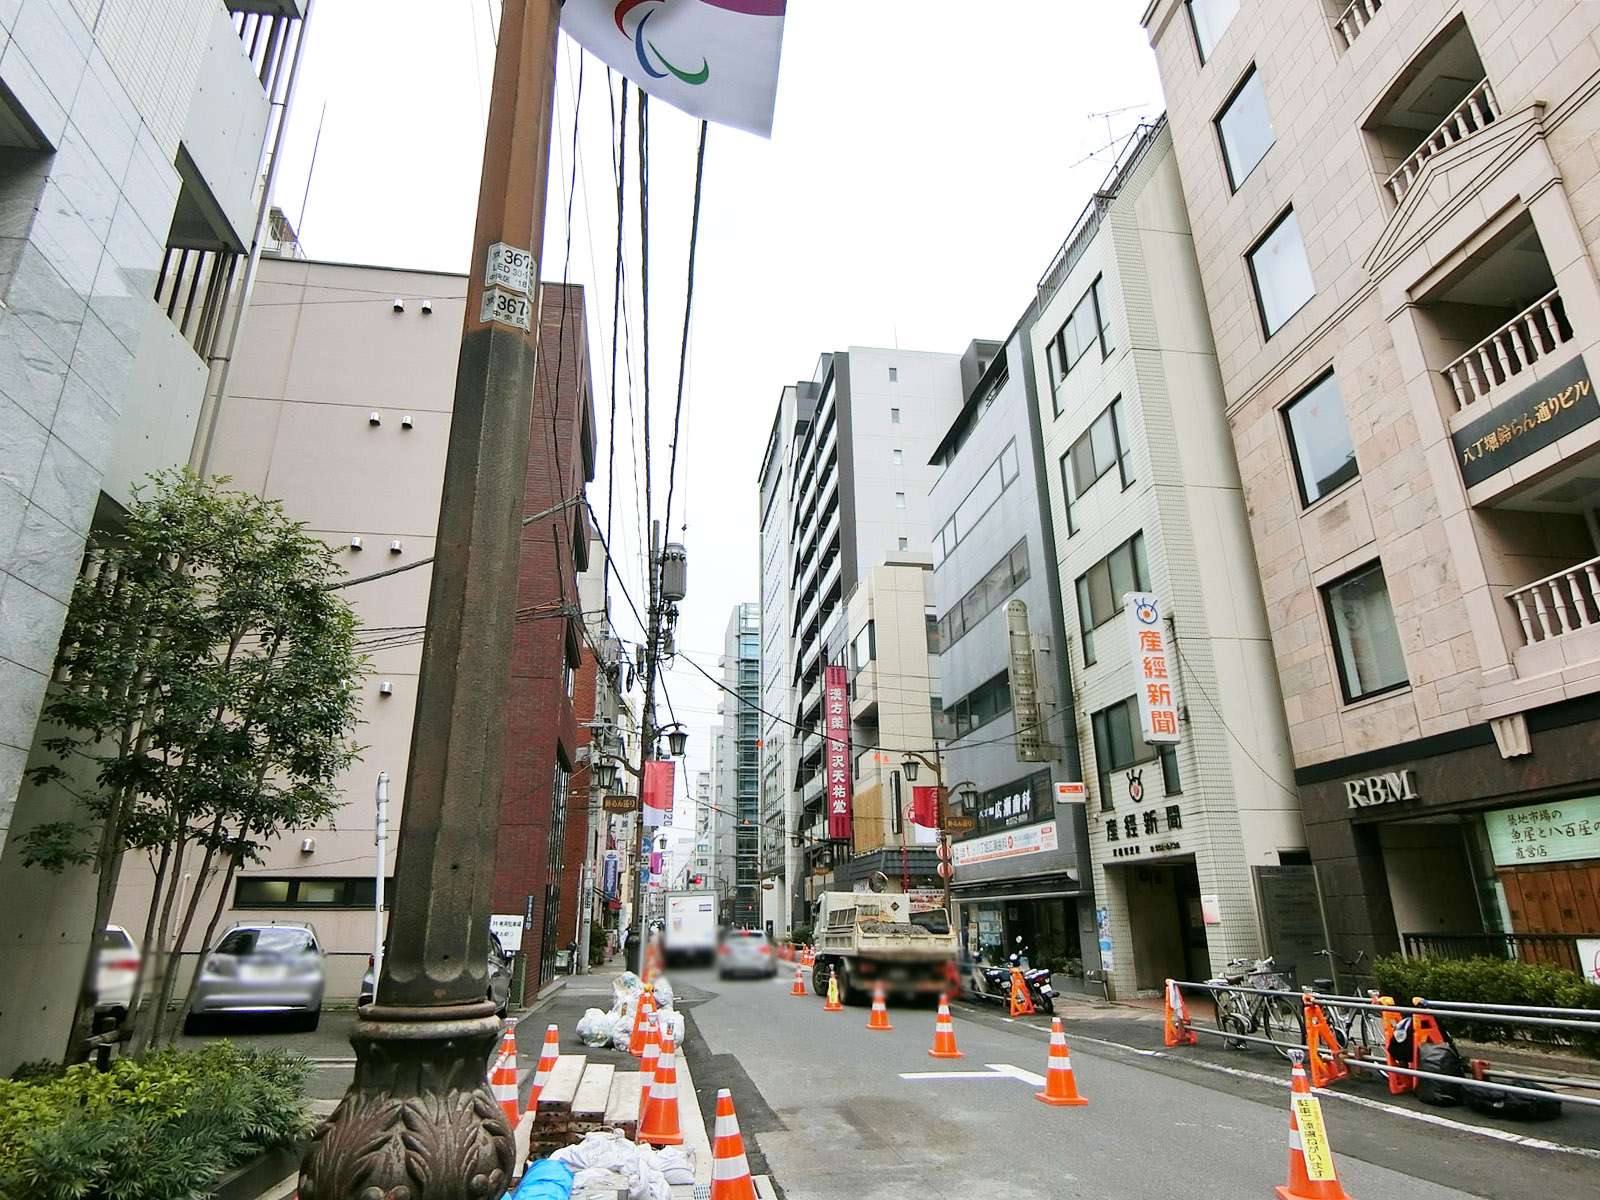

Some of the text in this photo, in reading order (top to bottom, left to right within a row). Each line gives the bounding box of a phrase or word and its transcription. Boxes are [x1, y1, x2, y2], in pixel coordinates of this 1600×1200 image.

[493, 263, 510, 273] LED
[504, 249, 530, 269] 367
[497, 295, 526, 316] 367
[493, 310, 524, 324] 中央区
[1463, 379, 1590, 466] 八丁堀鈴らん通りビル
[1138, 630, 1177, 734] 産經新聞
[1342, 769, 1418, 809] RBM
[1507, 809, 1562, 826] 築地市場の
[1511, 819, 1600, 844] 魚屋と八百屋の
[1515, 844, 1548, 859] 直営店
